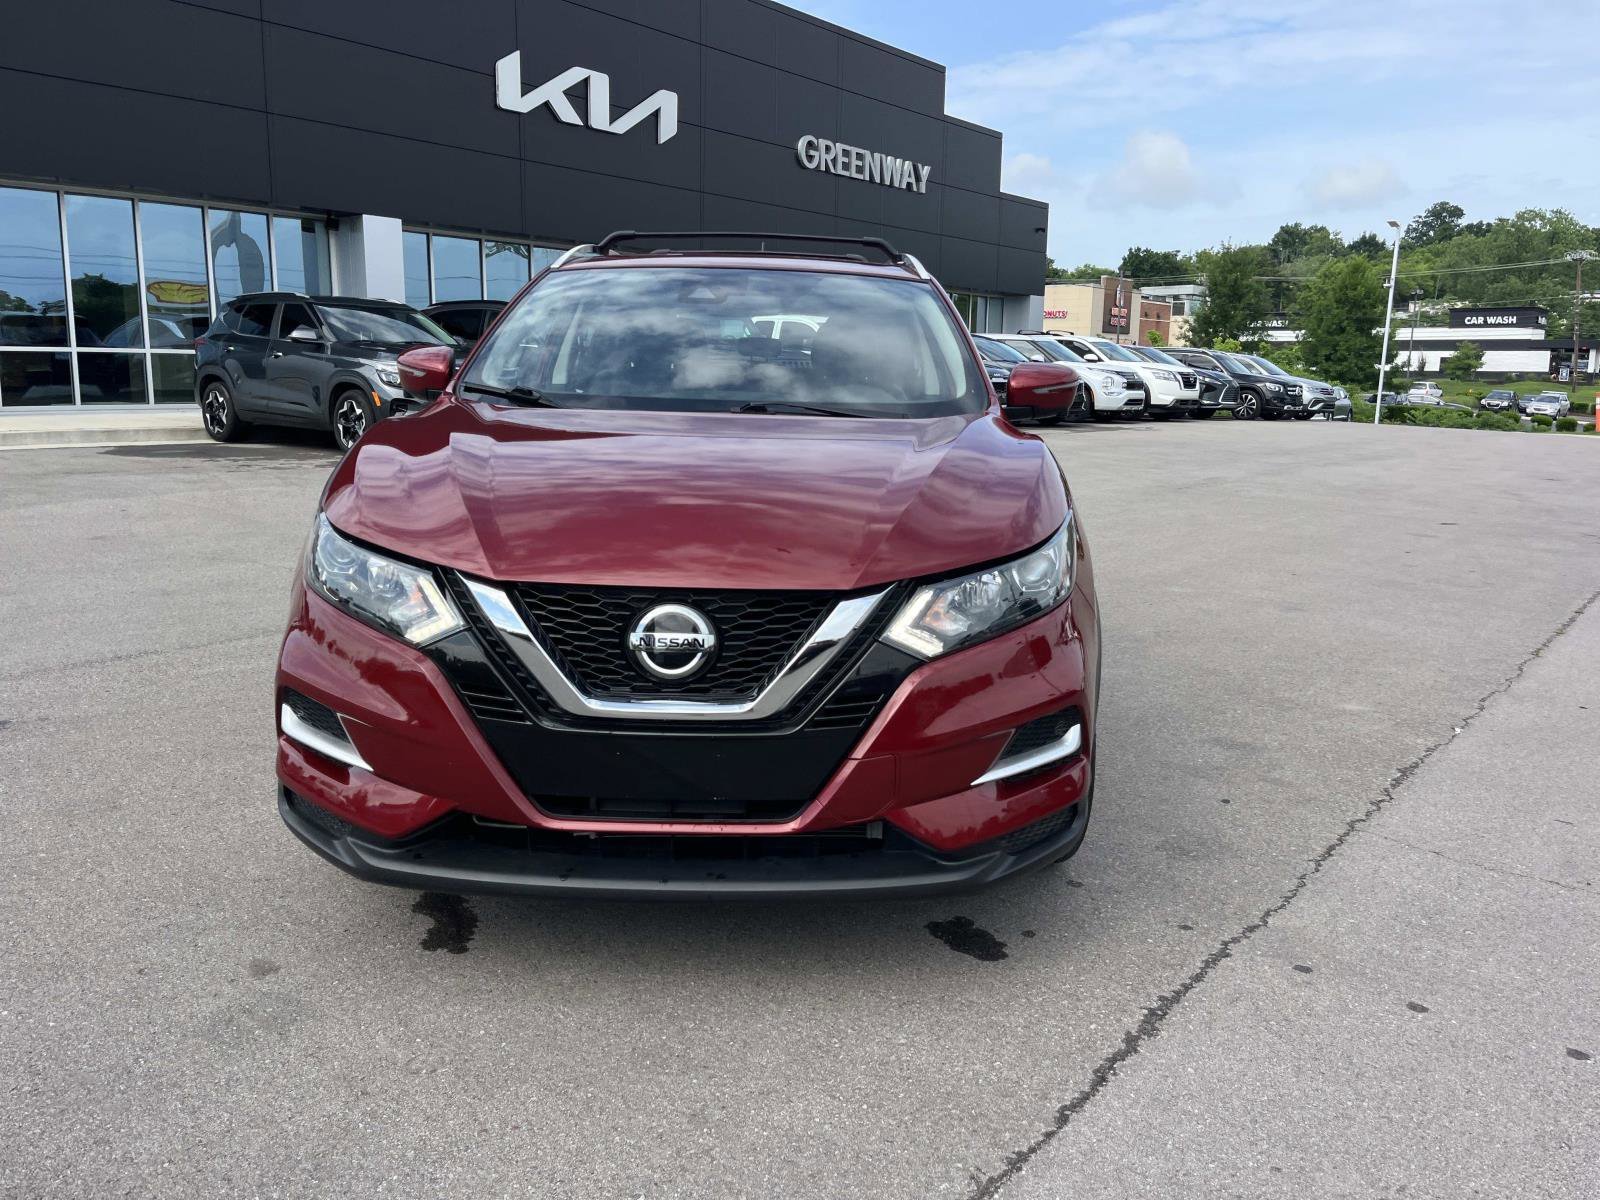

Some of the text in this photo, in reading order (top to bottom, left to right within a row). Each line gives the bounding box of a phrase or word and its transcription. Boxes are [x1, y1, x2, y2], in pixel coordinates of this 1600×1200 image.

[495, 50, 678, 144] KIA
[797, 134, 932, 194] GREENWAY
[1464, 316, 1517, 324] CAR WASH
[639, 636, 705, 649] NISSAN
